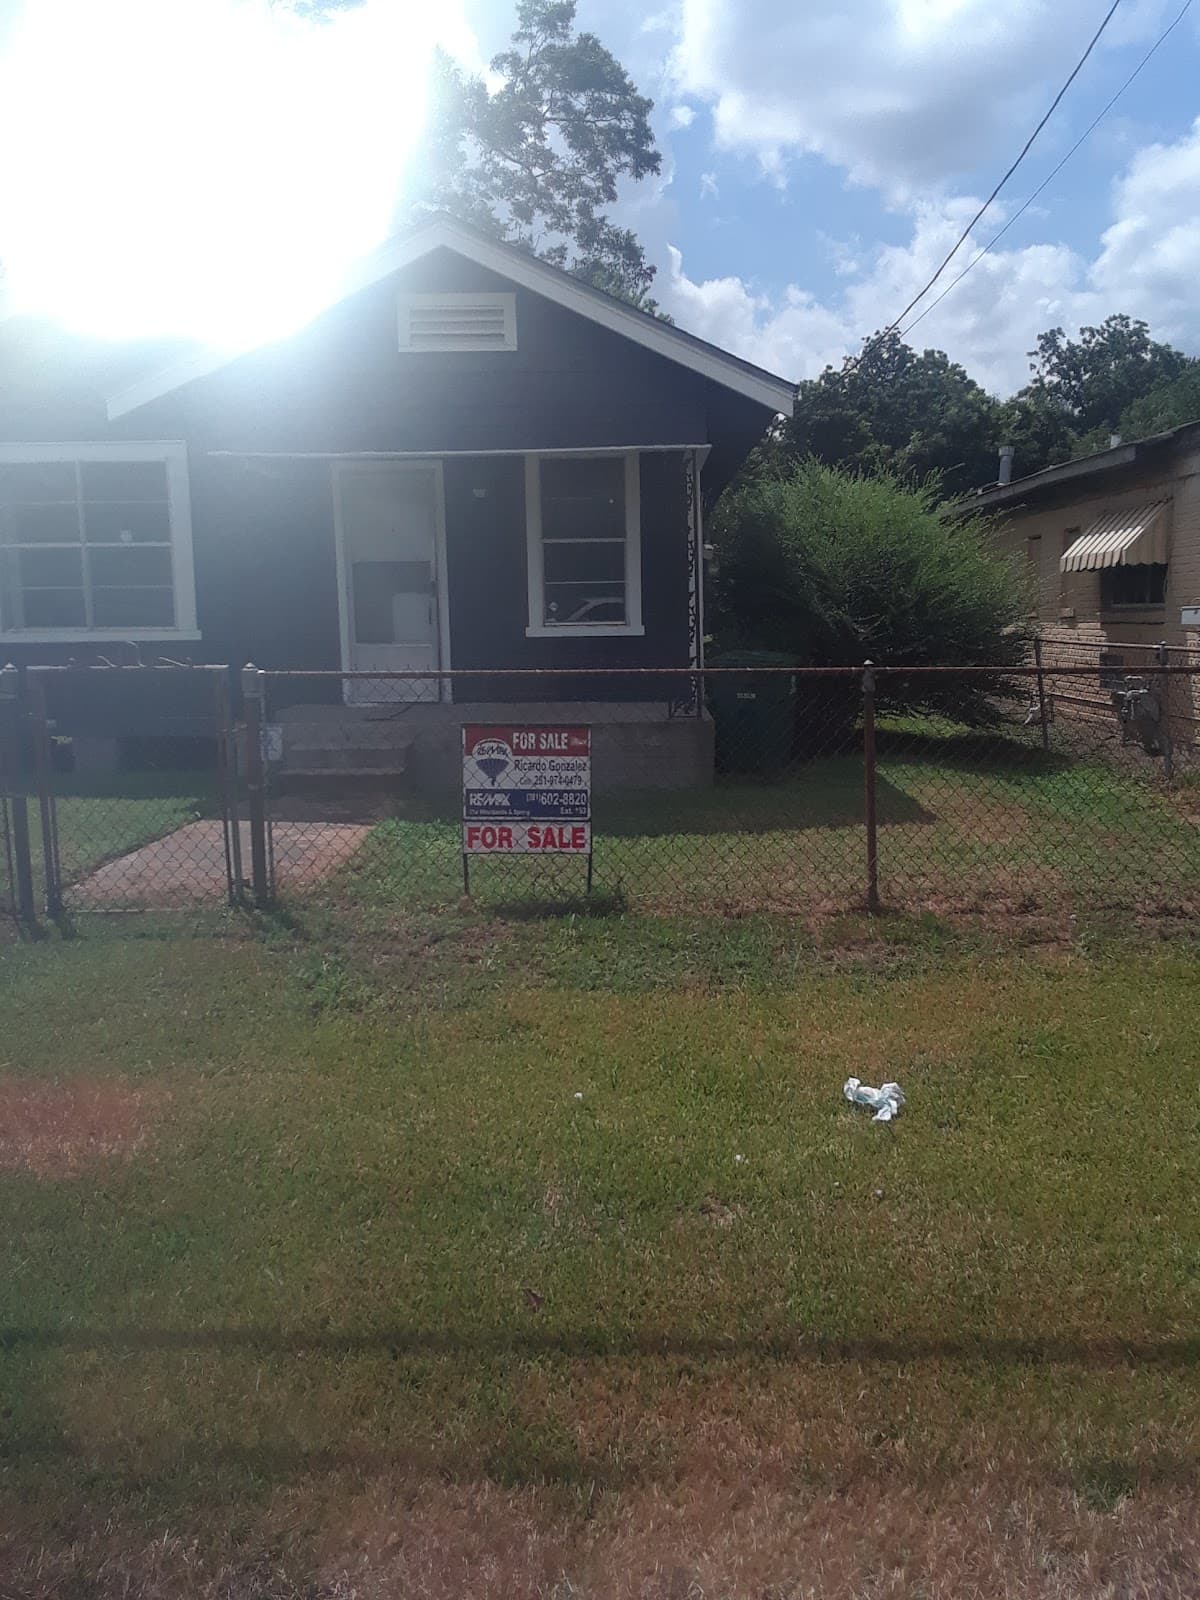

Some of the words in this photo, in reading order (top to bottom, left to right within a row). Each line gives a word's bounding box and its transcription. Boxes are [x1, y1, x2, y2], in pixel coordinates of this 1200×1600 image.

[512, 732, 536, 750] FOR
[540, 732, 568, 750] SALE
[514, 759, 546, 771] Ricardo
[549, 759, 587, 771] Gonzalez
[469, 793, 511, 806] RE/MAX
[541, 793, 587, 806] 602-8820
[468, 826, 513, 849] FOR
[527, 826, 586, 849] SALE
